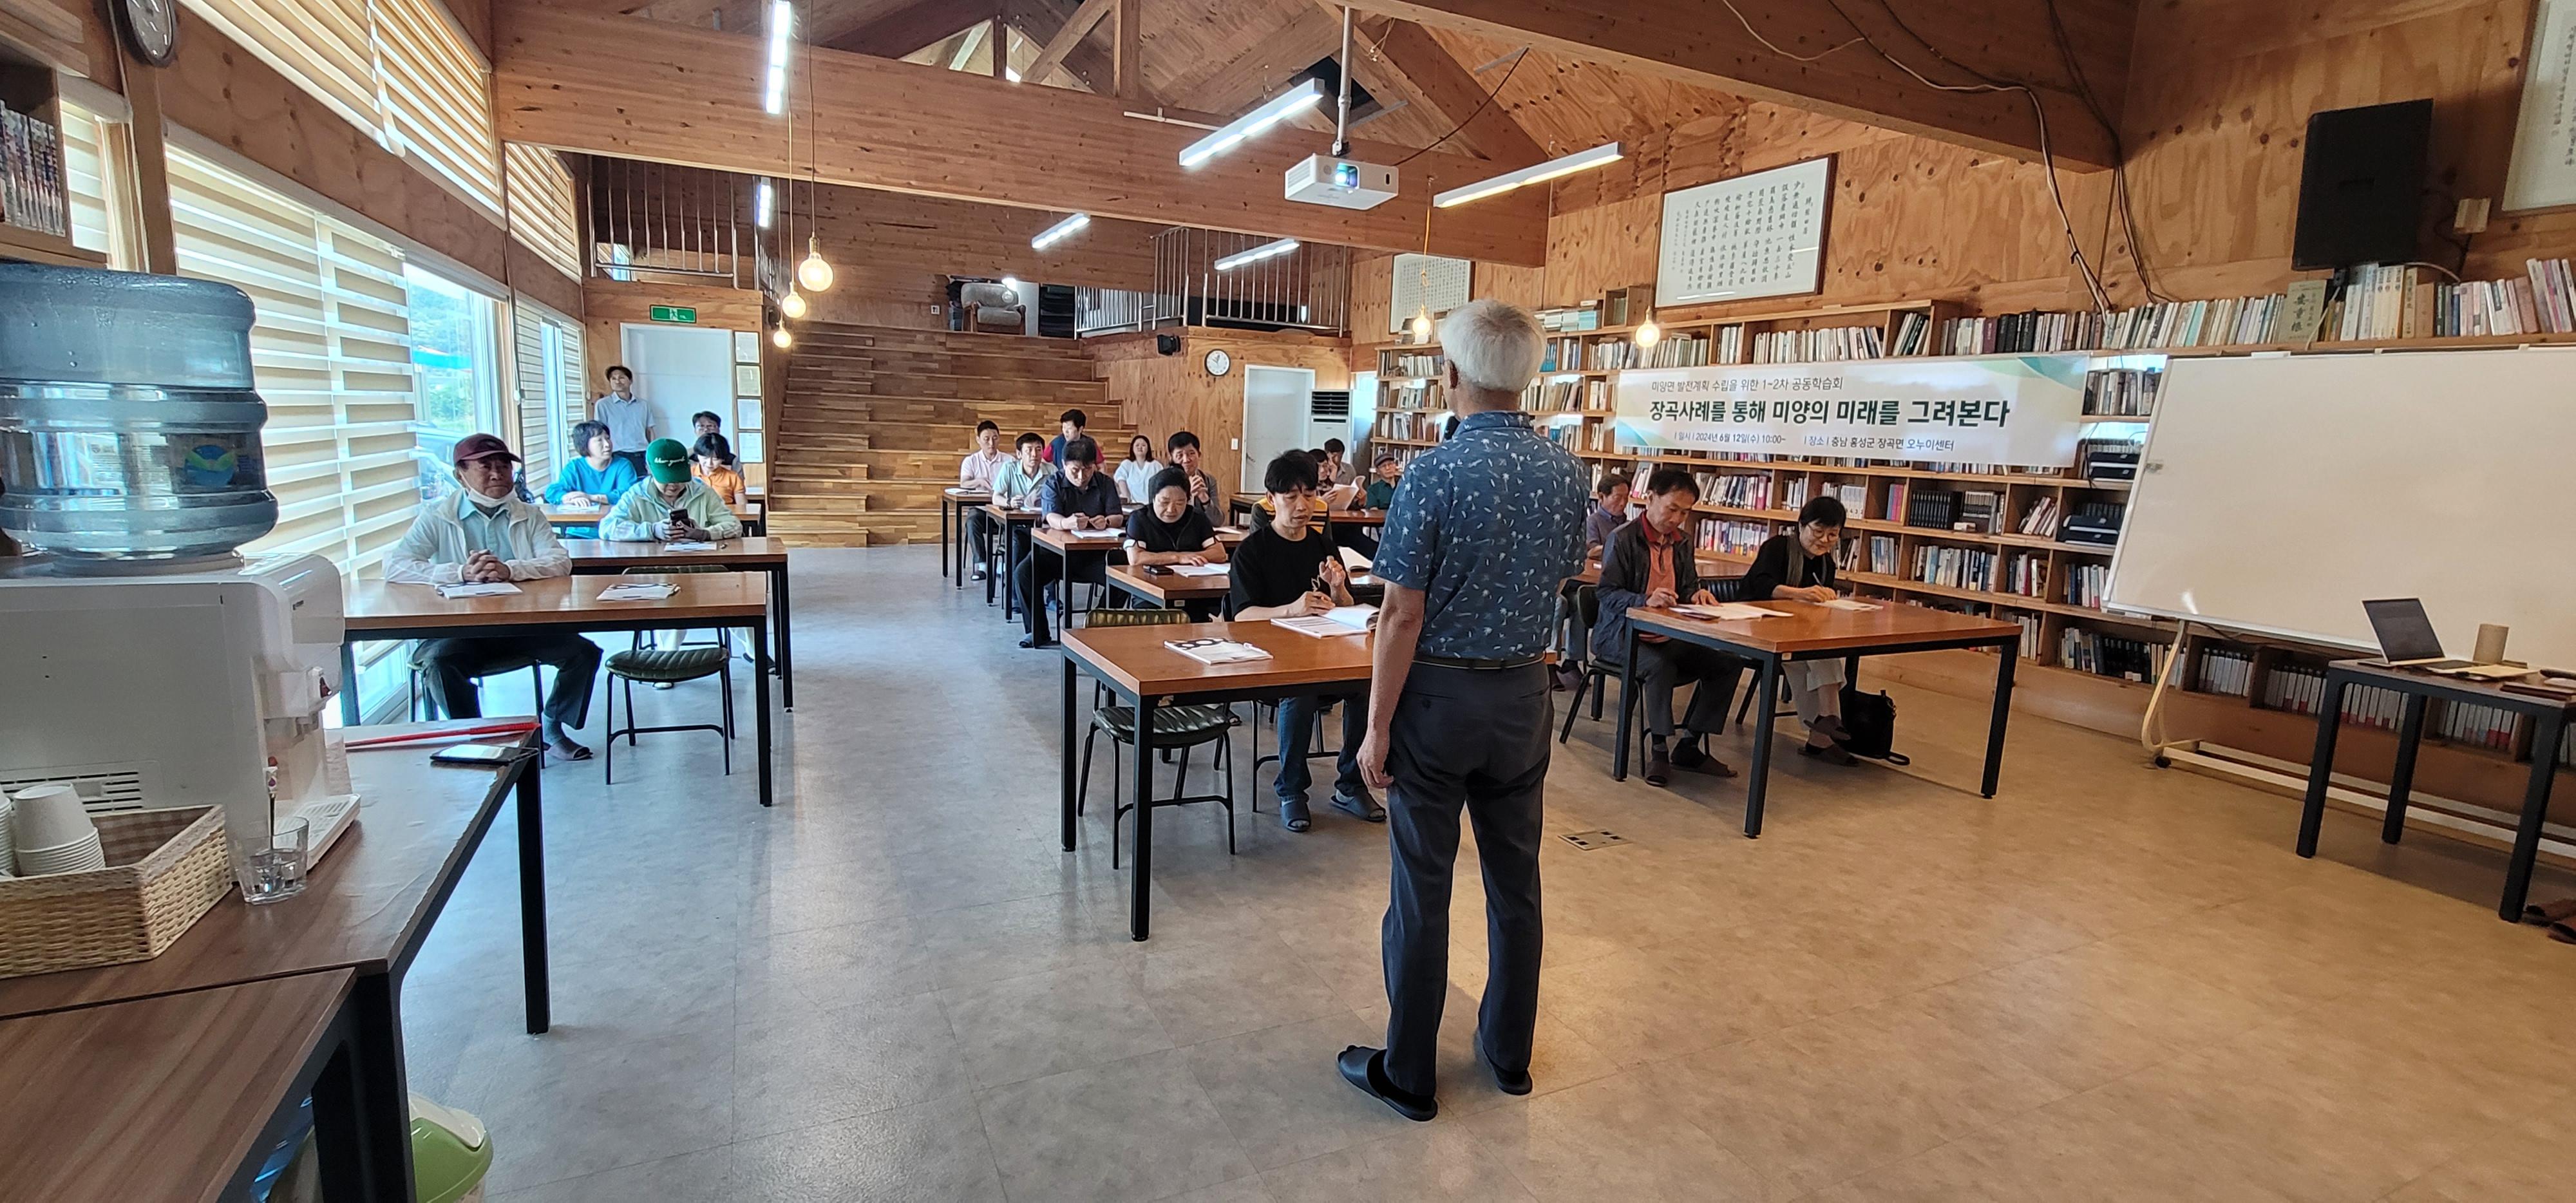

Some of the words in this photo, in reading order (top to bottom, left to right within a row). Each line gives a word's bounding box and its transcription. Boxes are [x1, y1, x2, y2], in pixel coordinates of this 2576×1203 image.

[1652, 381, 1674, 393] 미양면
[1677, 380, 1710, 392] 발전계획
[1712, 379, 1738, 392] 수립을
[1741, 378, 1759, 392] 위한
[1763, 378, 1788, 391] 1~2차
[1792, 377, 1844, 391] 공동학습회
[1649, 400, 1726, 422] 장곡사례를
[1732, 400, 1766, 422] 통해
[1772, 400, 1830, 424] 미양의
[1836, 400, 1900, 426] 미래를
[1908, 400, 2011, 428] 그려본다
[1678, 432, 1690, 441] 일시
[1696, 432, 1718, 442] 2024년
[1719, 433, 1730, 443] 6월
[1732, 433, 1759, 444] 12일(수)
[1762, 434, 1786, 444] 10:00~
[1809, 436, 1824, 446] 장소
[1831, 436, 1848, 448] 충남
[1850, 437, 1875, 449] 홍성군
[1877, 437, 1904, 450] 장곡면
[1906, 439, 1955, 451] 오누이센터
